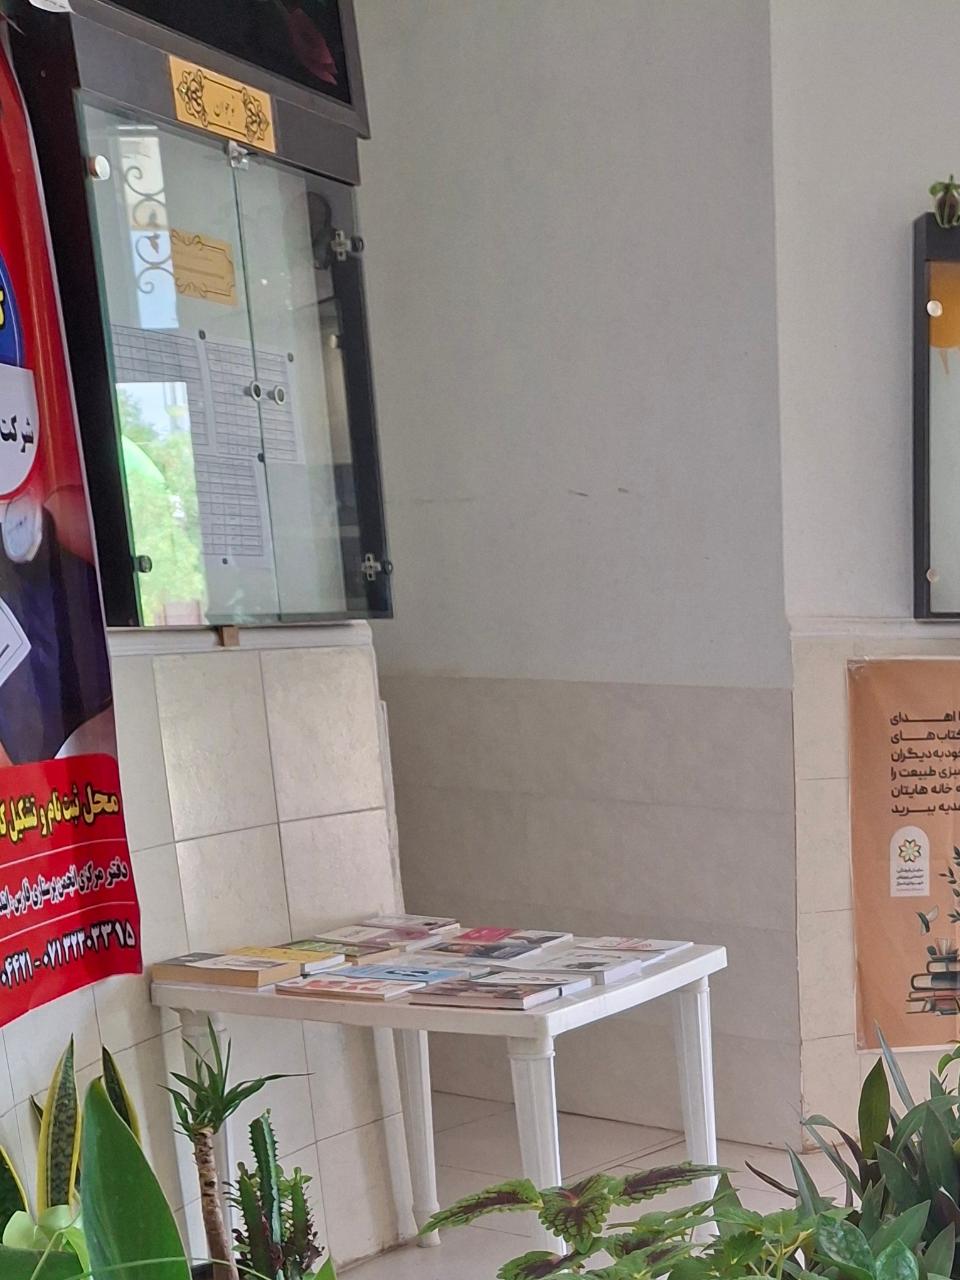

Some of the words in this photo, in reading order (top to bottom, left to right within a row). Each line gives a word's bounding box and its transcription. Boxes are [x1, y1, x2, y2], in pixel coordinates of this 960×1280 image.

[890, 711, 956, 726] اهدای
[890, 729, 936, 744] های
[891, 747, 932, 763] دیگران
[933, 749, 944, 761] به
[890, 766, 897, 781] را
[899, 765, 936, 780] طبیعت
[891, 783, 928, 798] هایتان
[931, 783, 952, 794] خانه
[82, 785, 119, 824] محل
[891, 804, 936, 816] ببرید
[78, 860, 104, 894] مرکزی
[105, 856, 129, 888] دفتر
